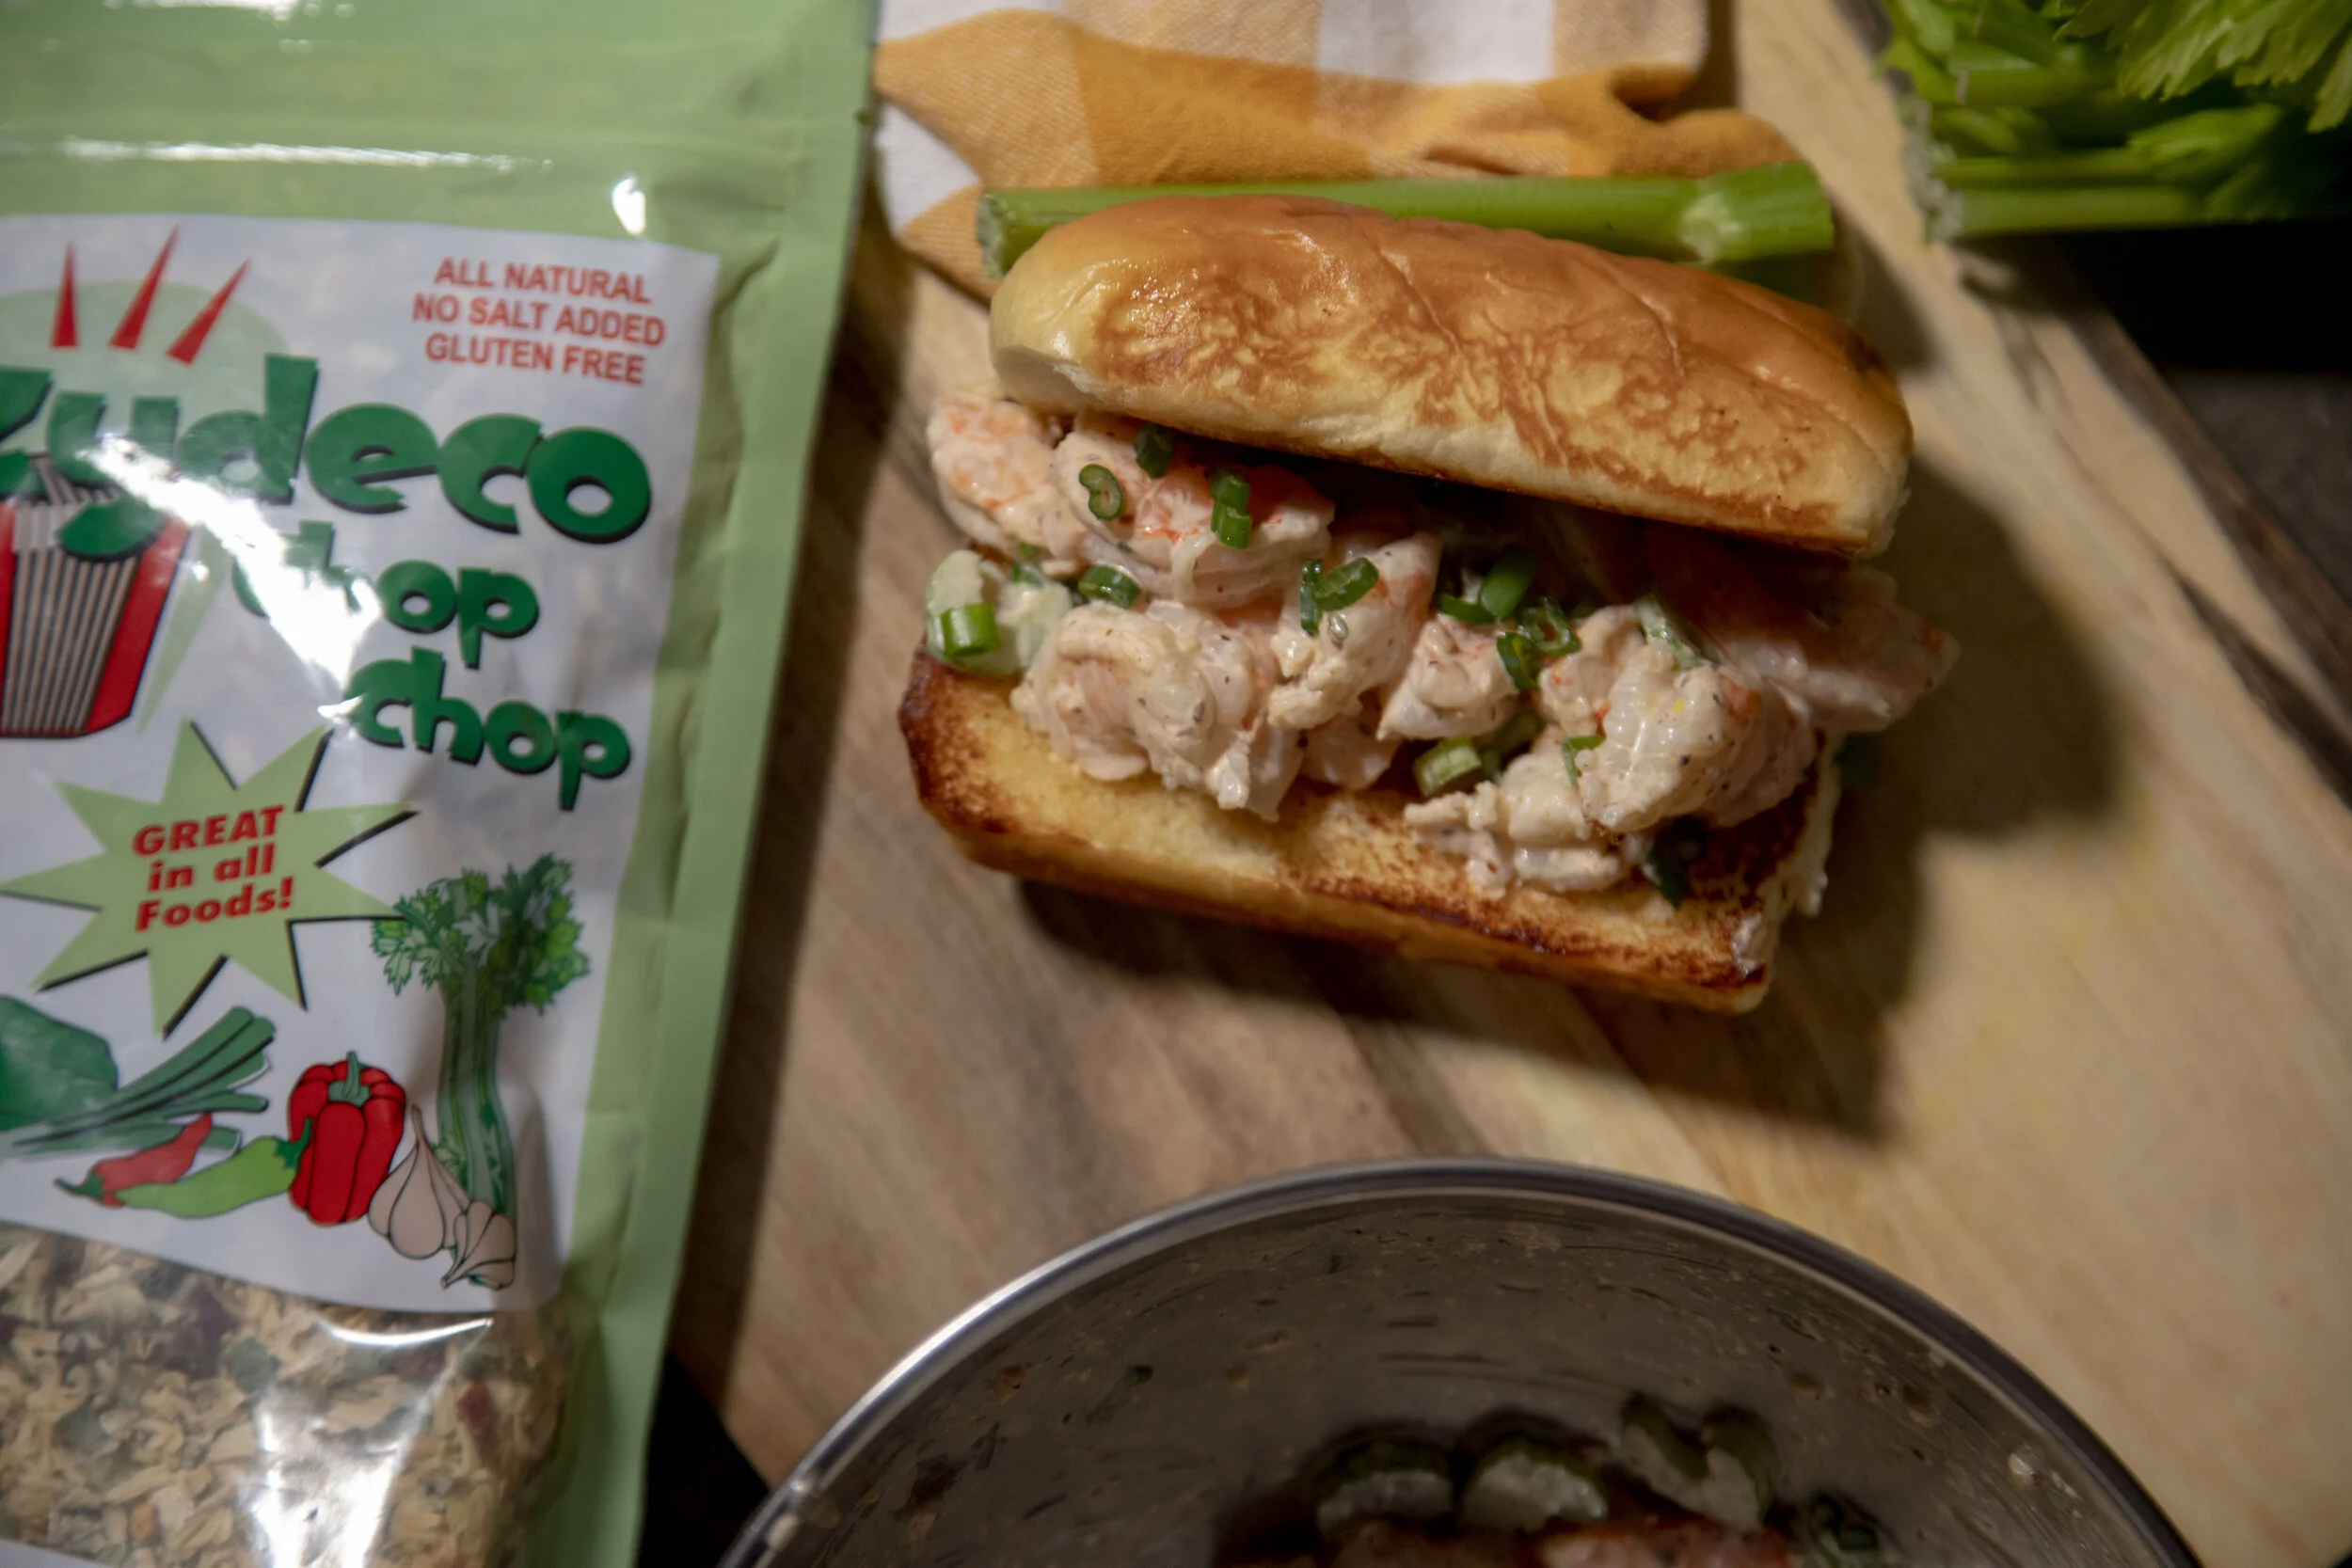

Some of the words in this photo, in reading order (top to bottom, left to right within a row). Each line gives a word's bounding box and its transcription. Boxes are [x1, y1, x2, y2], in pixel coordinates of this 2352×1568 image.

[434, 257, 494, 289] ALL
[503, 261, 652, 305] NATURAL
[412, 293, 460, 323] NO
[468, 296, 549, 330] SALT
[554, 305, 667, 347] ADDED
[425, 332, 553, 372] GLUTEN
[562, 344, 646, 386] FREE
[342, 645, 631, 812] chop
[132, 804, 284, 858] GREAT
[148, 860, 194, 893] in
[213, 842, 276, 882] all
[135, 876, 294, 933] Foods!
